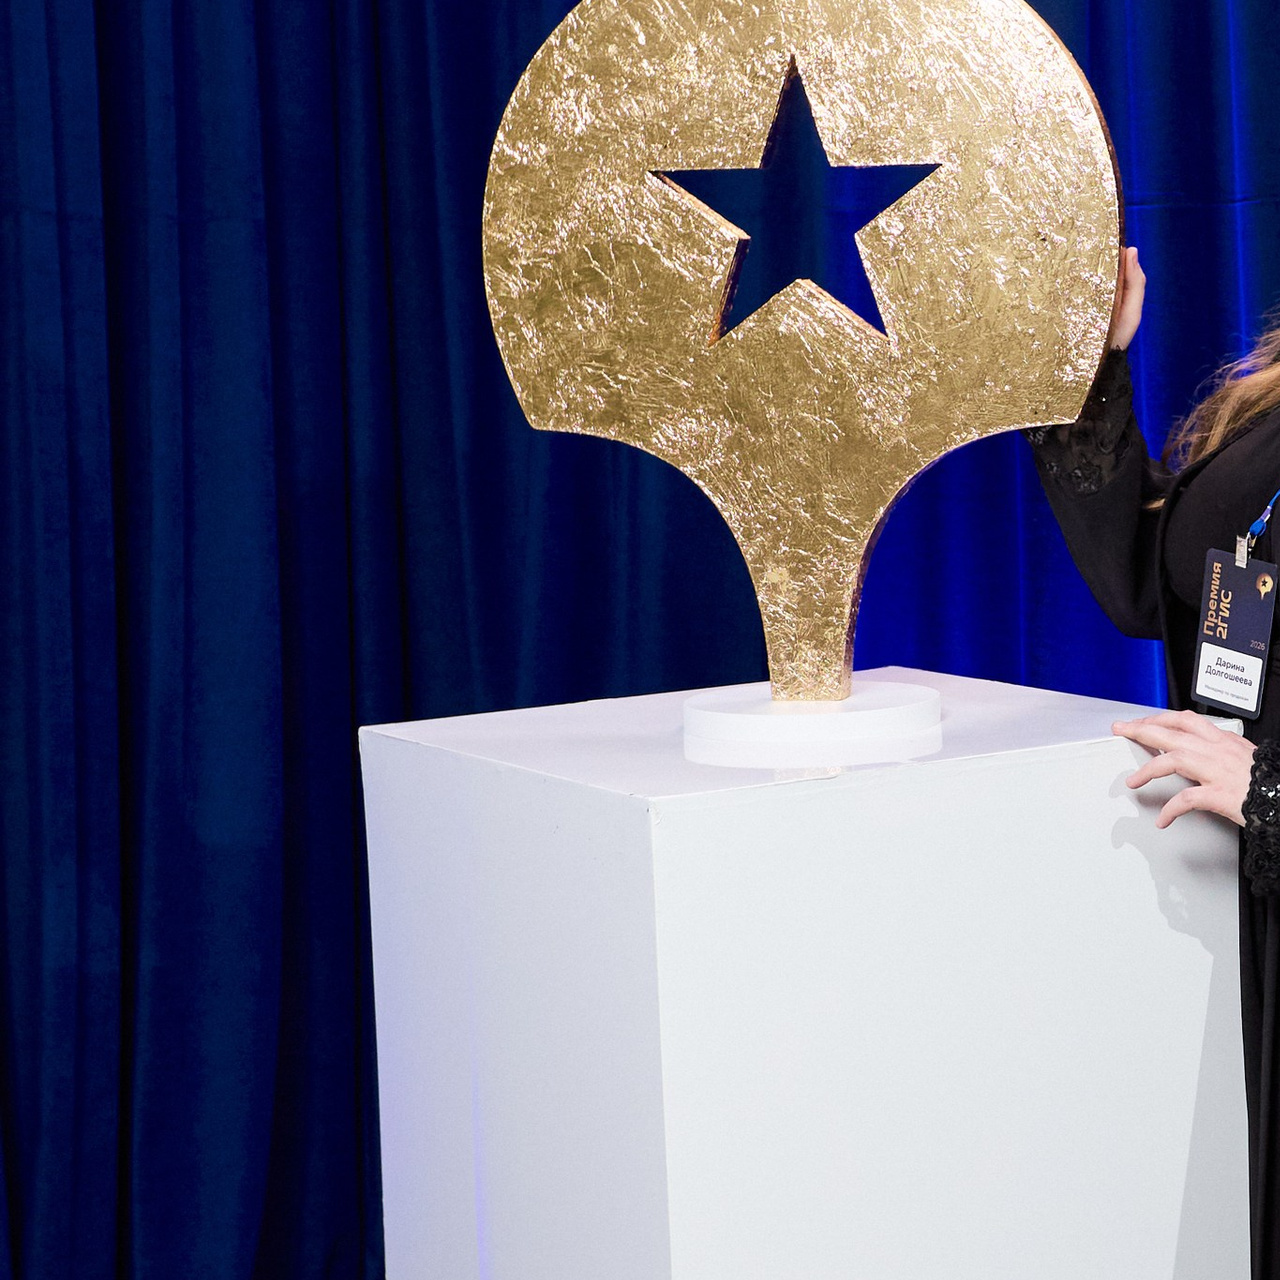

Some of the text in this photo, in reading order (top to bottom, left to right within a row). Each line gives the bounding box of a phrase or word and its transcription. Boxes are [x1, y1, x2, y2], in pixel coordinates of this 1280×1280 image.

[1203, 562, 1222, 636] Премия
[1216, 589, 1232, 640] 2ГИС
[1250, 639, 1266, 651] 2026
[1205, 664, 1253, 687] Долгошеева
[1215, 656, 1245, 673] Дарина
